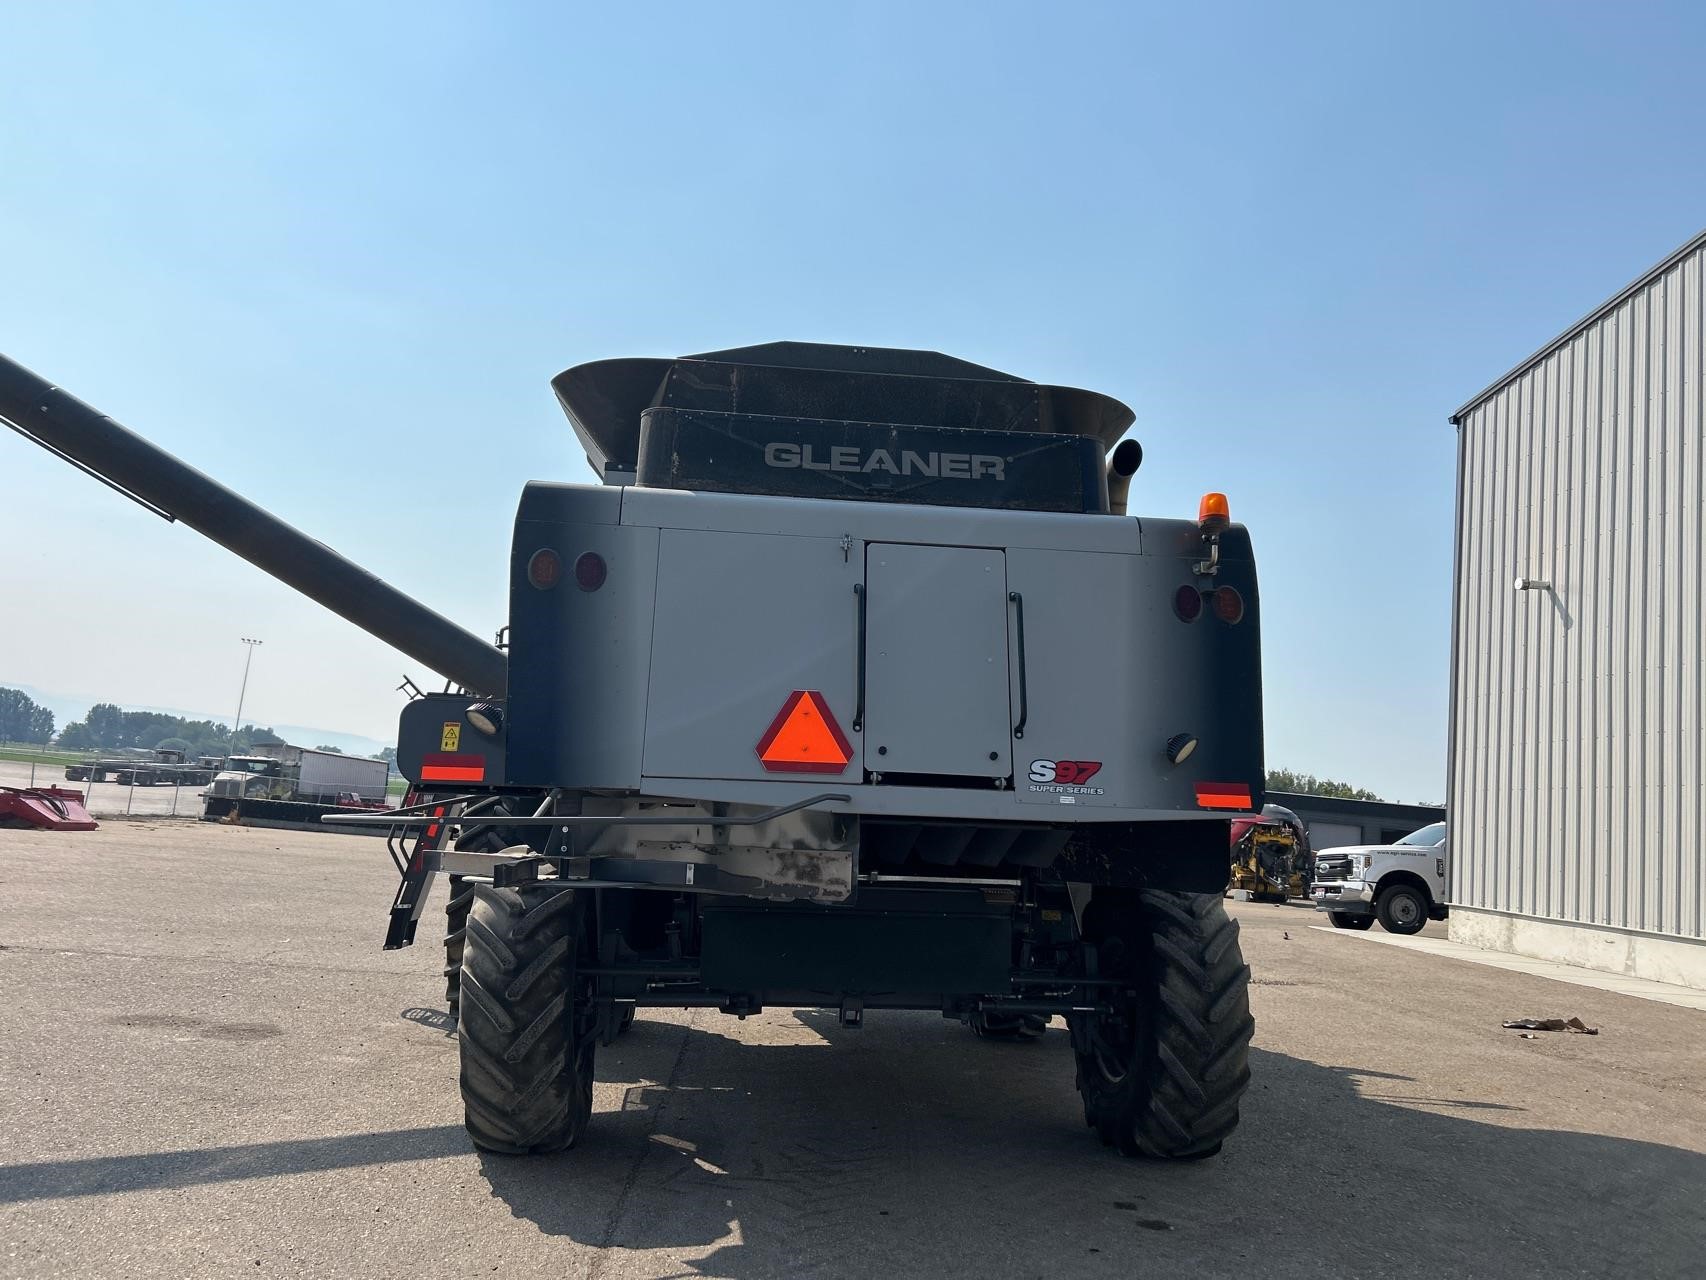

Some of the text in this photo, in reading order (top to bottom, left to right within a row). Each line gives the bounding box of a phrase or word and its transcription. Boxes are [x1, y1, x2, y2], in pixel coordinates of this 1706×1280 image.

[764, 442, 1005, 480] GLEANER
[1028, 759, 1102, 785] S97
[1029, 785, 1104, 795] SUPER SERIES
